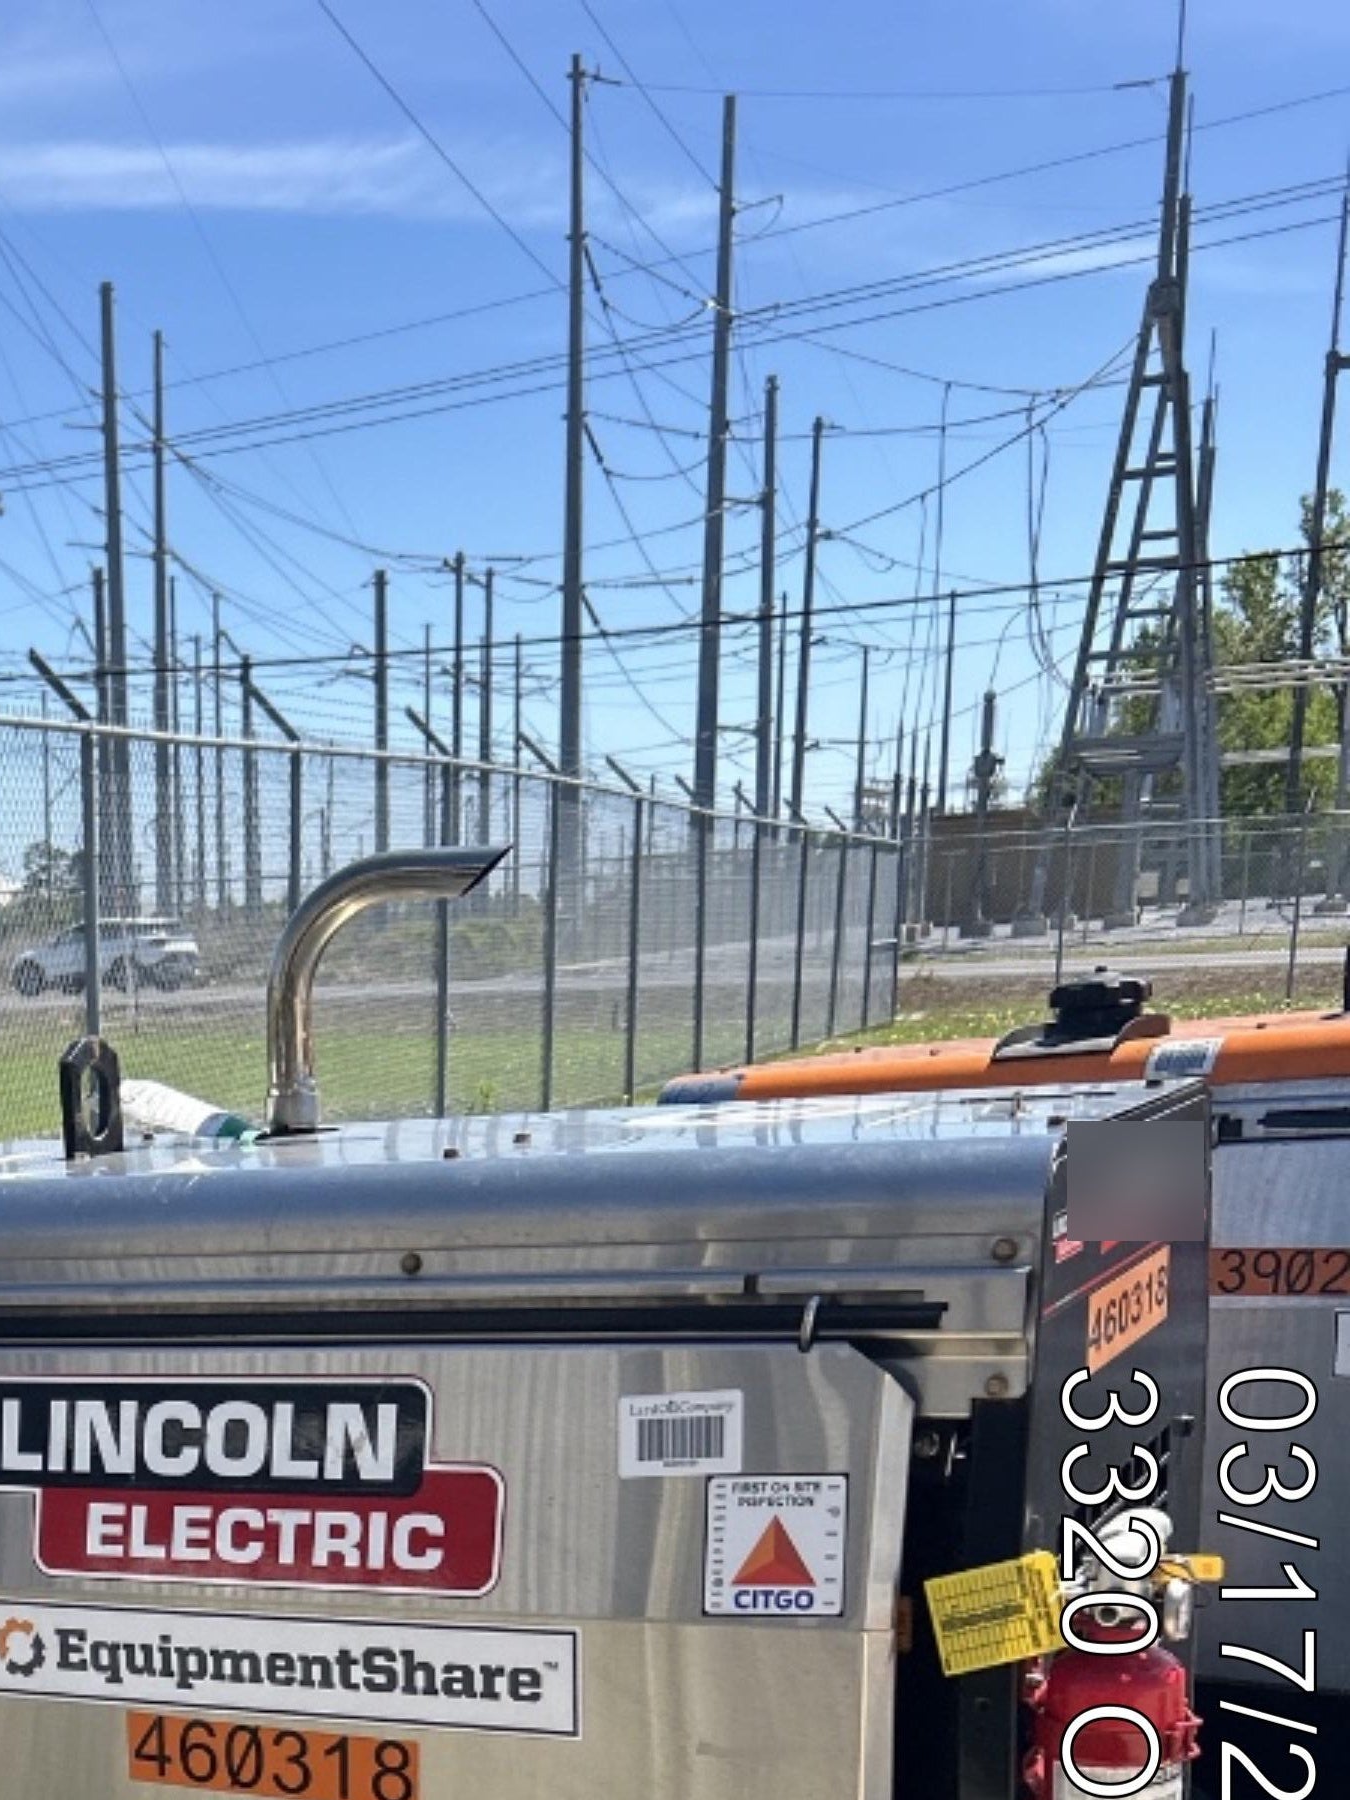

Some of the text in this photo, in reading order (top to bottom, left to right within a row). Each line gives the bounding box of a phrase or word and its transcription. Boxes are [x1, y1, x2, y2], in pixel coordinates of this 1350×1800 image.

[1089, 1265, 1168, 1351] 460318
[1, 1398, 398, 1482] LINCOLN
[86, 1501, 446, 1571] ELECTRIC
[734, 1590, 814, 1611] CITGO
